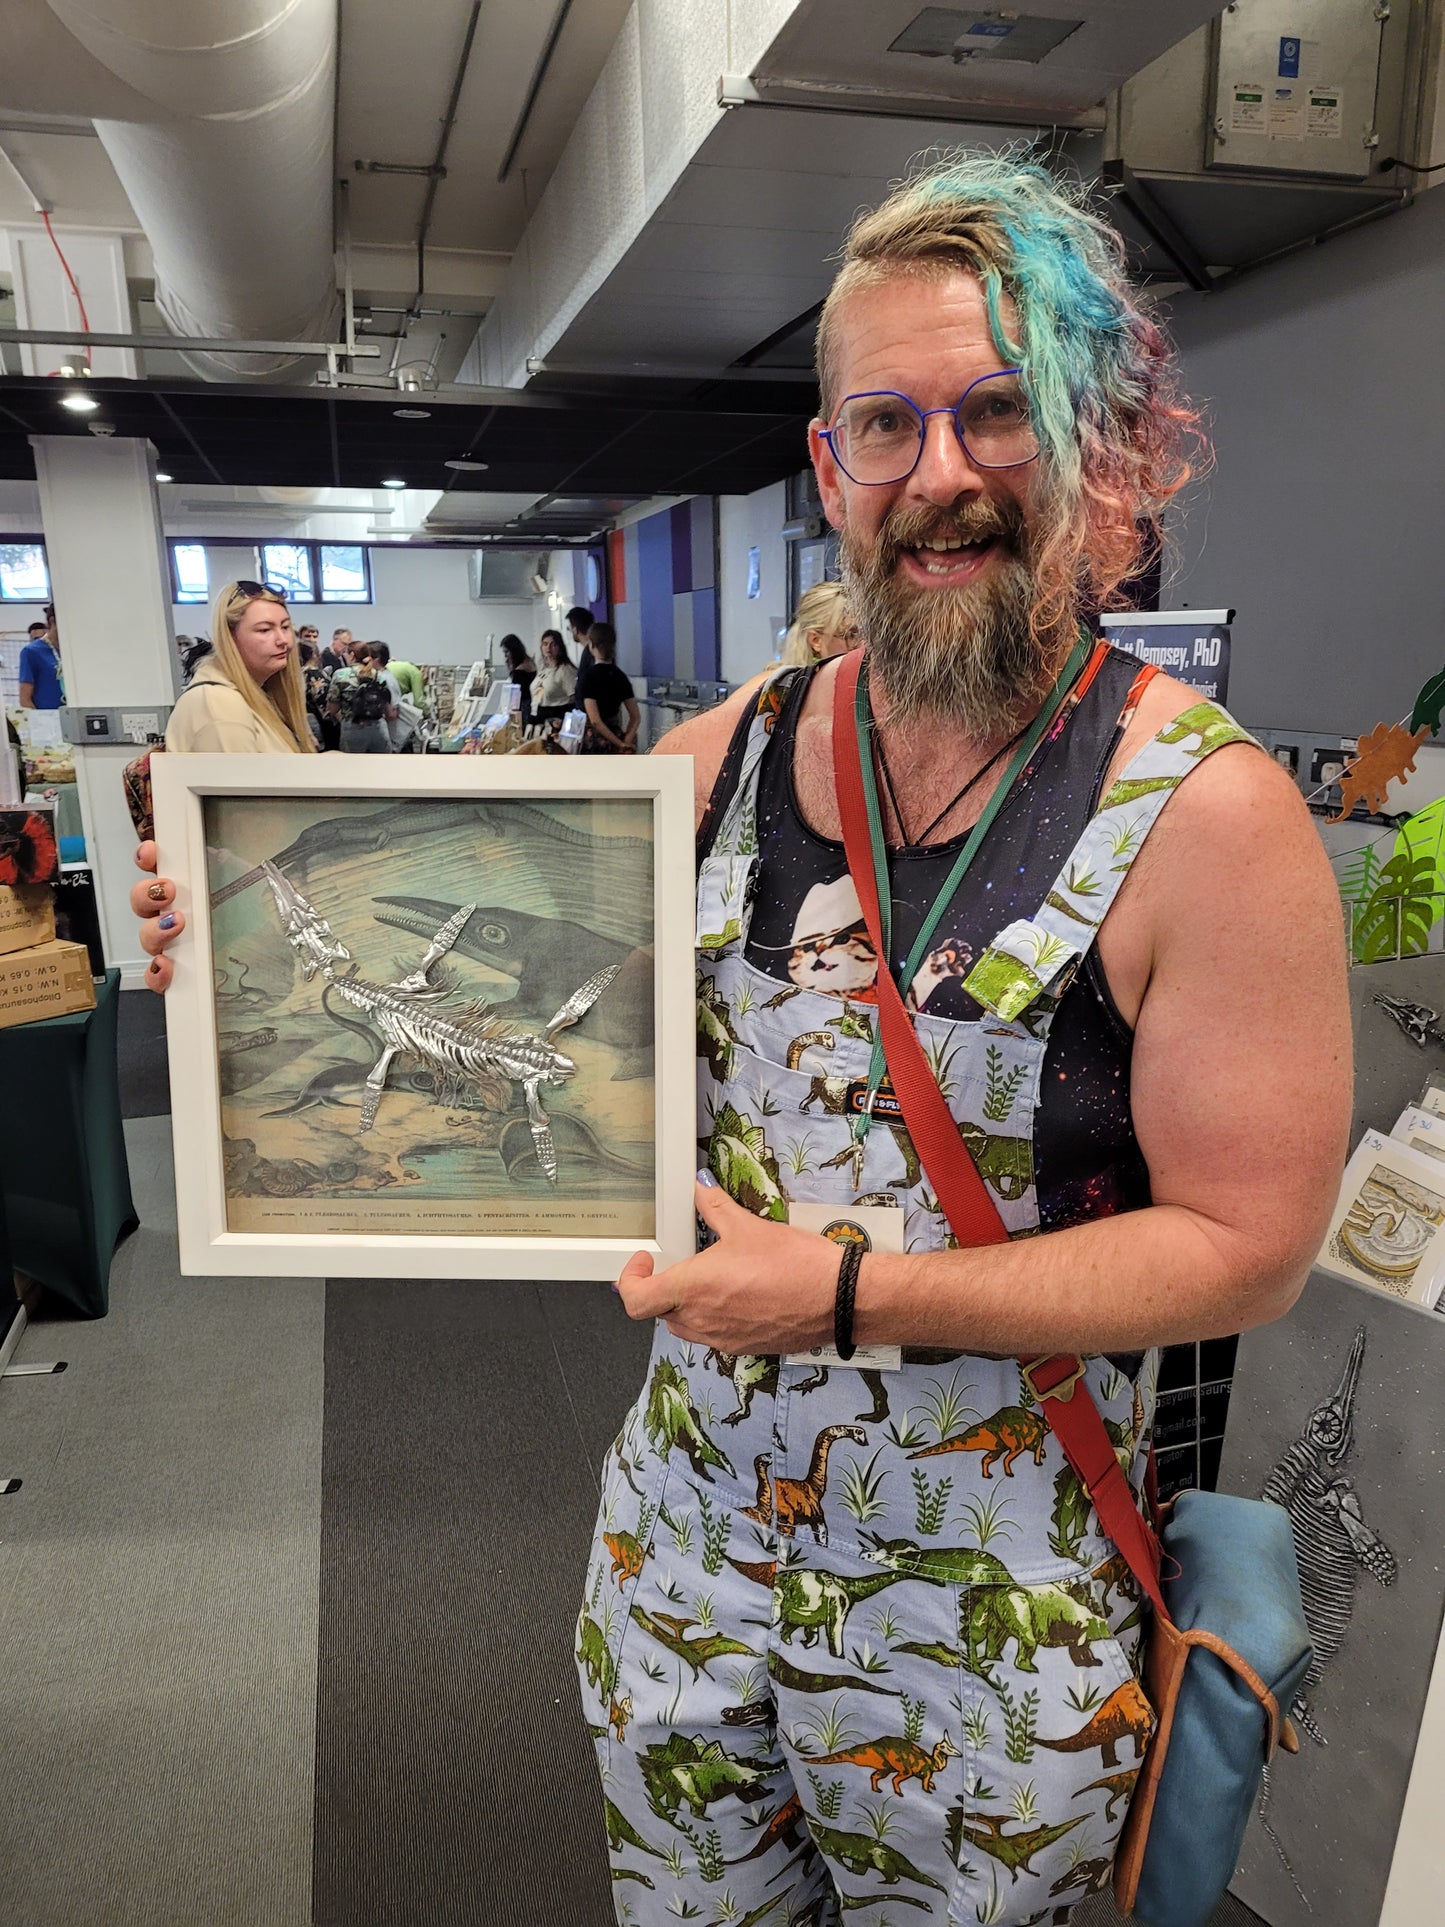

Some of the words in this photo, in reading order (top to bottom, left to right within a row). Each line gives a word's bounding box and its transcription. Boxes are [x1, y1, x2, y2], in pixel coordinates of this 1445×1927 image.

[1135, 638, 1190, 672] Dempsey,
[1192, 638, 1221, 667] PhD
[0, 992, 61, 1010] Dilophosauru
